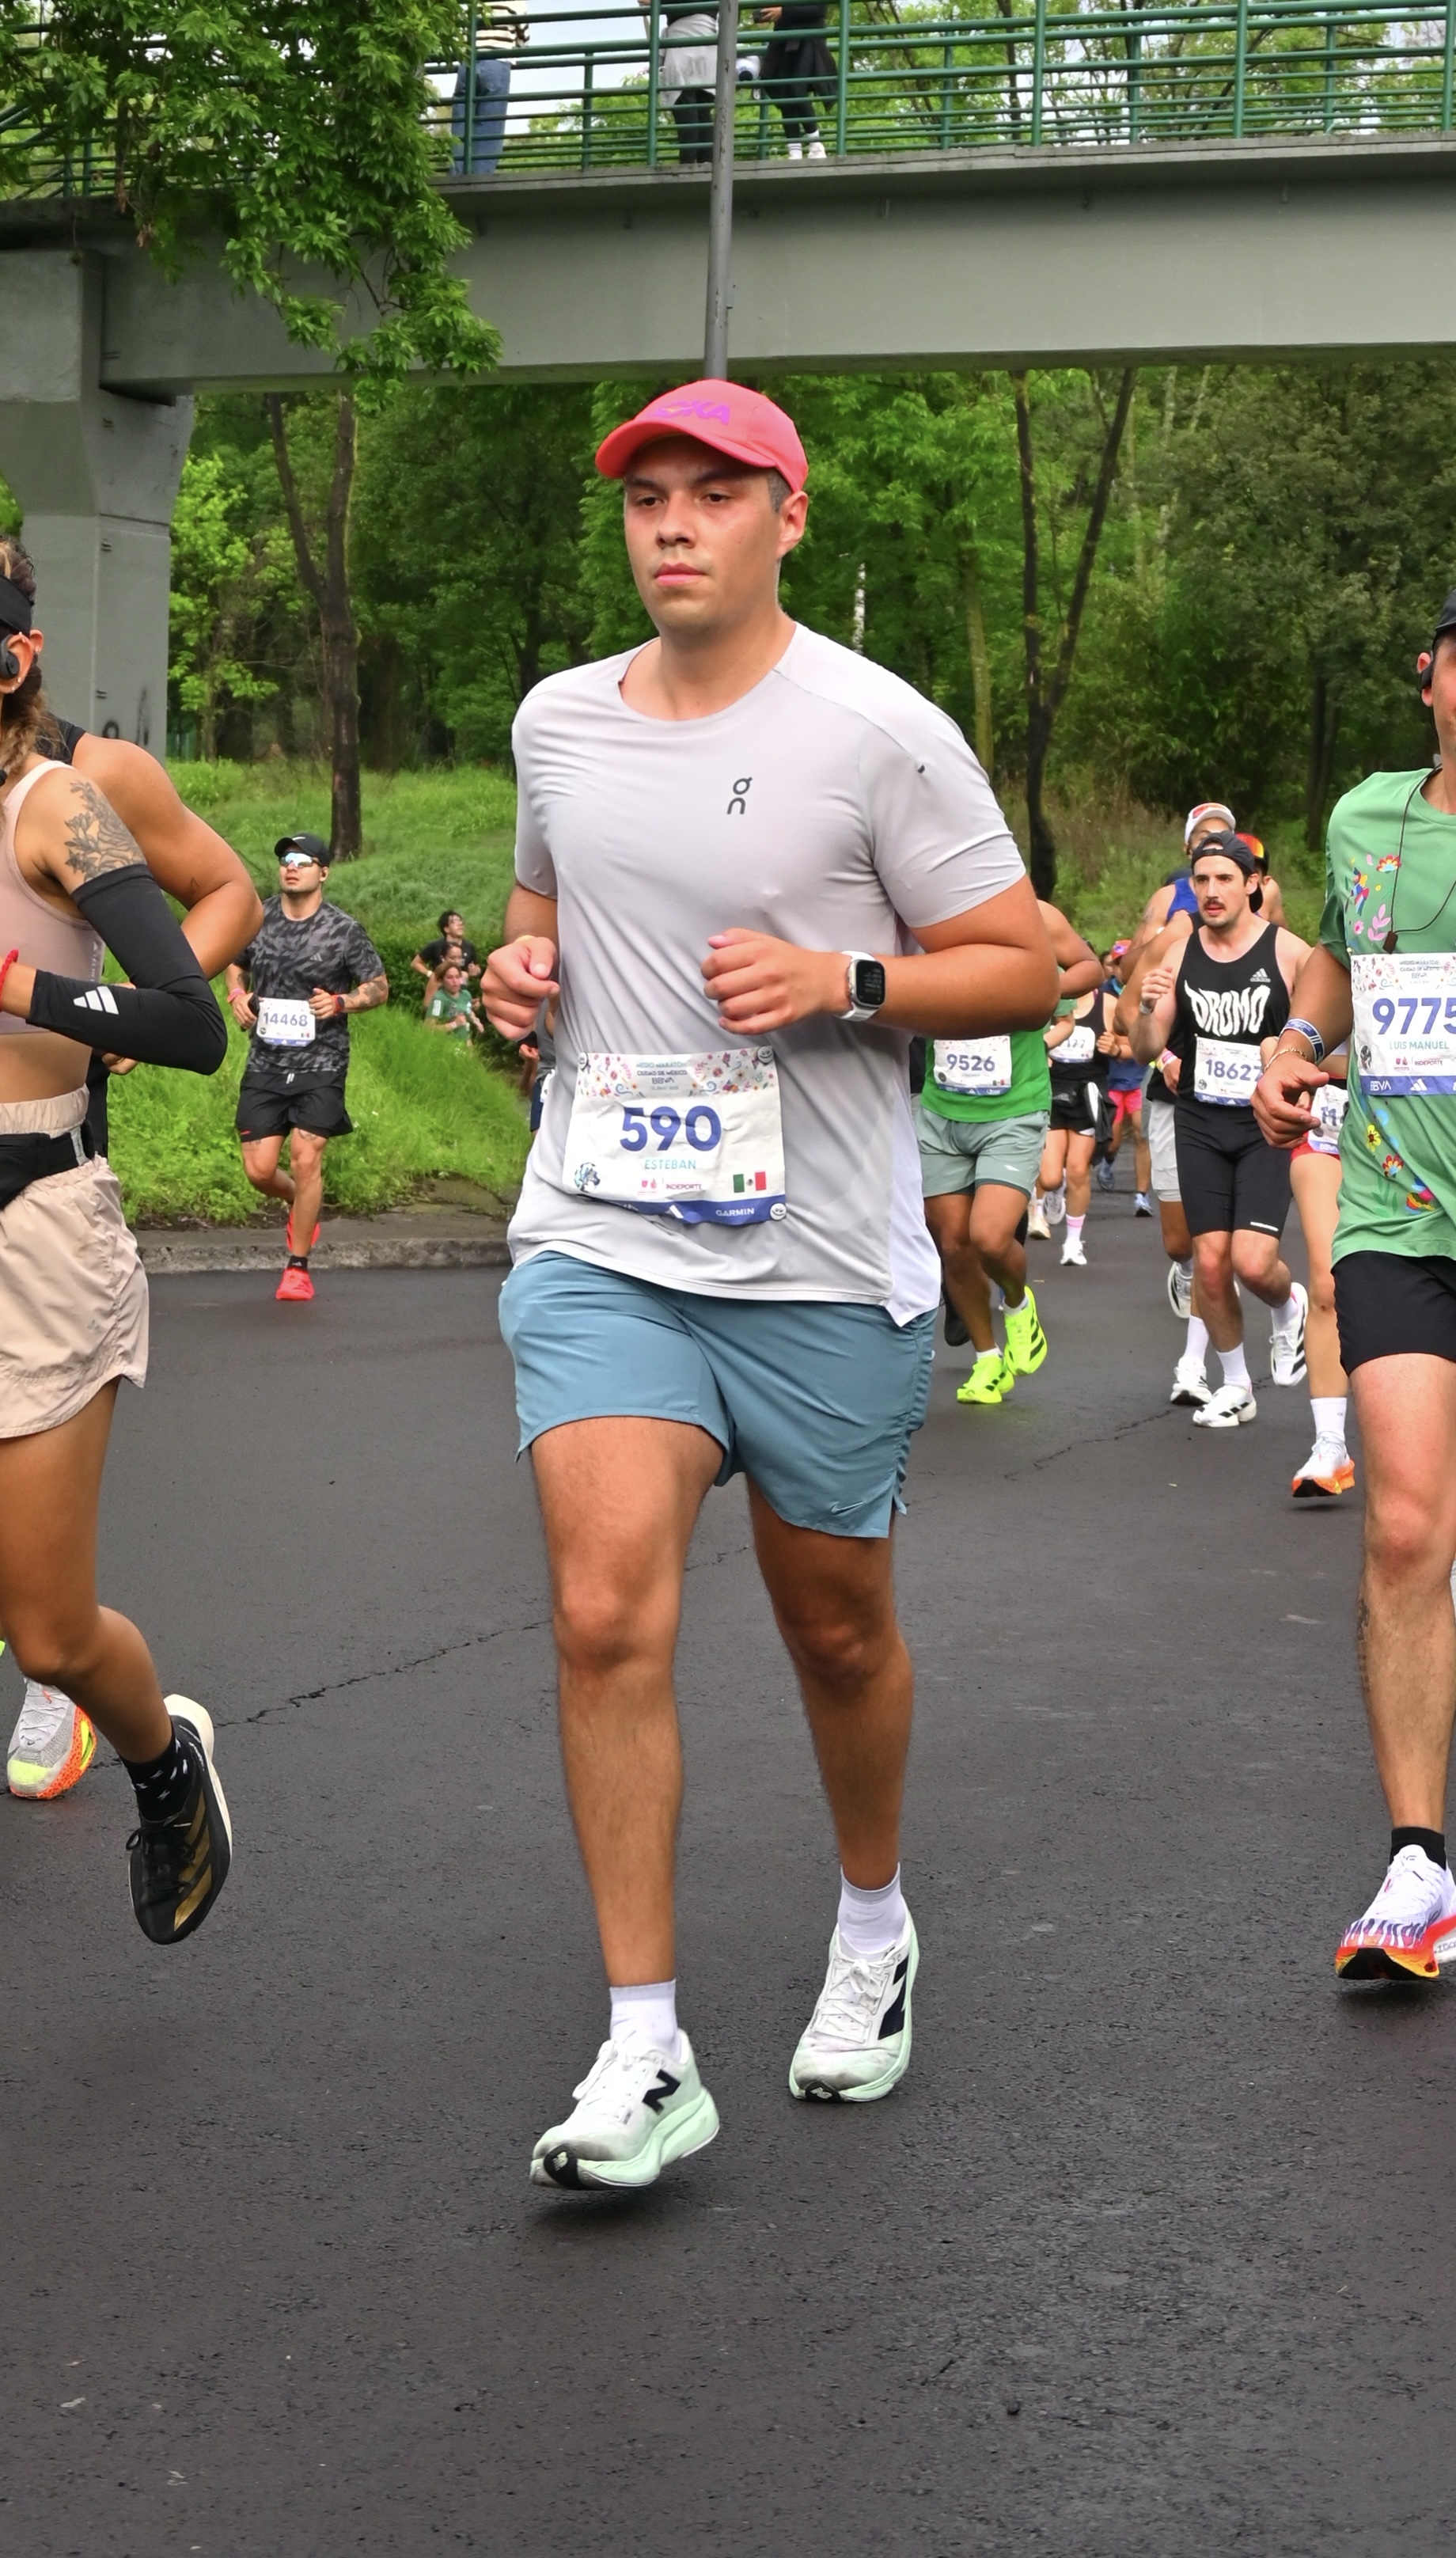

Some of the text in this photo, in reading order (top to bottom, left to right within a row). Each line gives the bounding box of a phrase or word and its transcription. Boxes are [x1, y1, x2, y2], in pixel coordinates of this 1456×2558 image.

[1184, 980, 1271, 1037] DROMO
[263, 1012, 308, 1027] 14468
[1390, 1040, 1449, 1050] LUIS MANUEL
[946, 1053, 995, 1072] 9526
[1370, 1080, 1392, 1091] BBVA
[620, 1105, 722, 1152] 590
[644, 1159, 696, 1171] ESTEBAN
[715, 1208, 754, 1217] GARMIN
